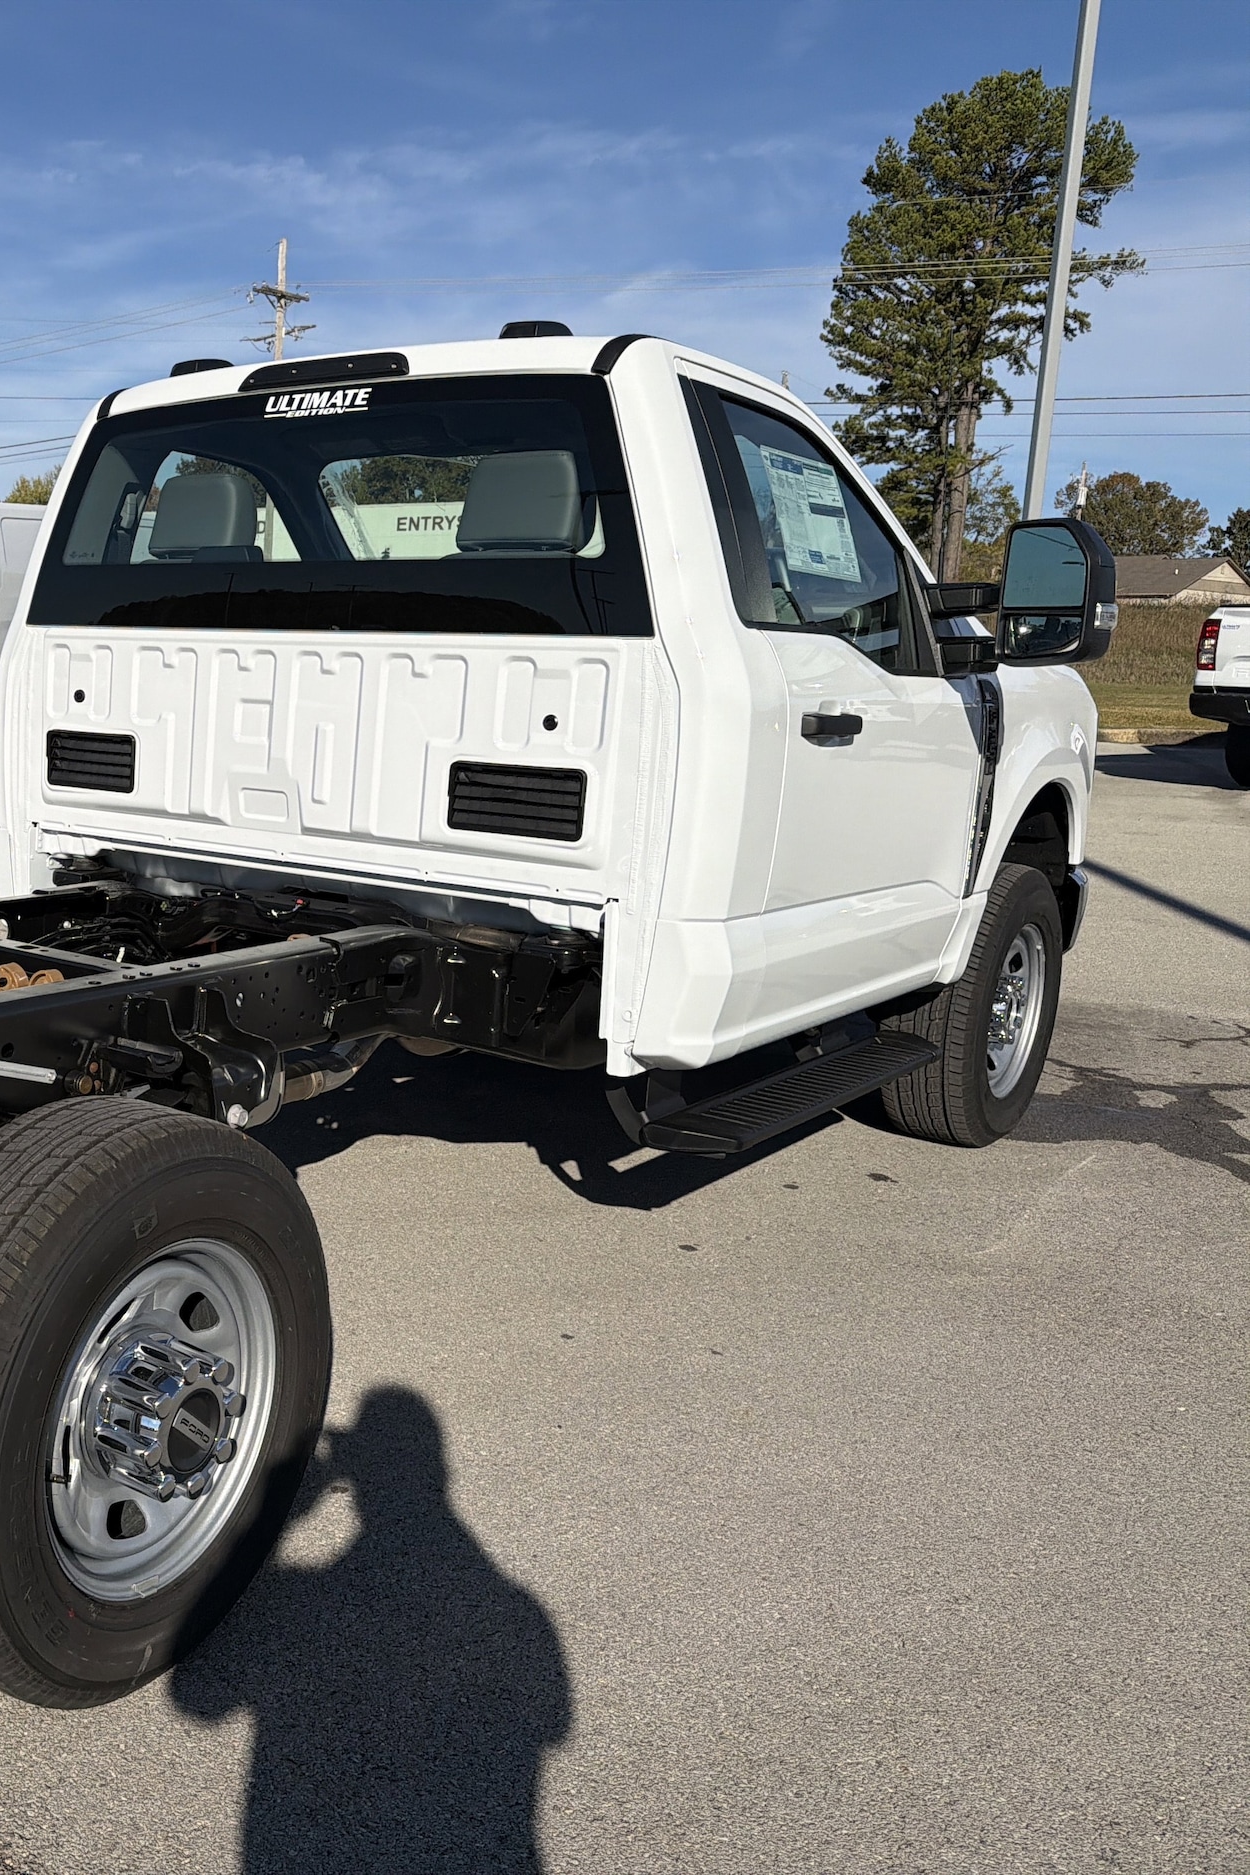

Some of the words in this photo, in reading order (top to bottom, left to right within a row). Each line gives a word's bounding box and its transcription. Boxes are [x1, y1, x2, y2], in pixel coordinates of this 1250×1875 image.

[265, 388, 372, 413] ULTIMATE
[285, 406, 347, 419] EDITION
[180, 1418, 210, 1443] FORD
